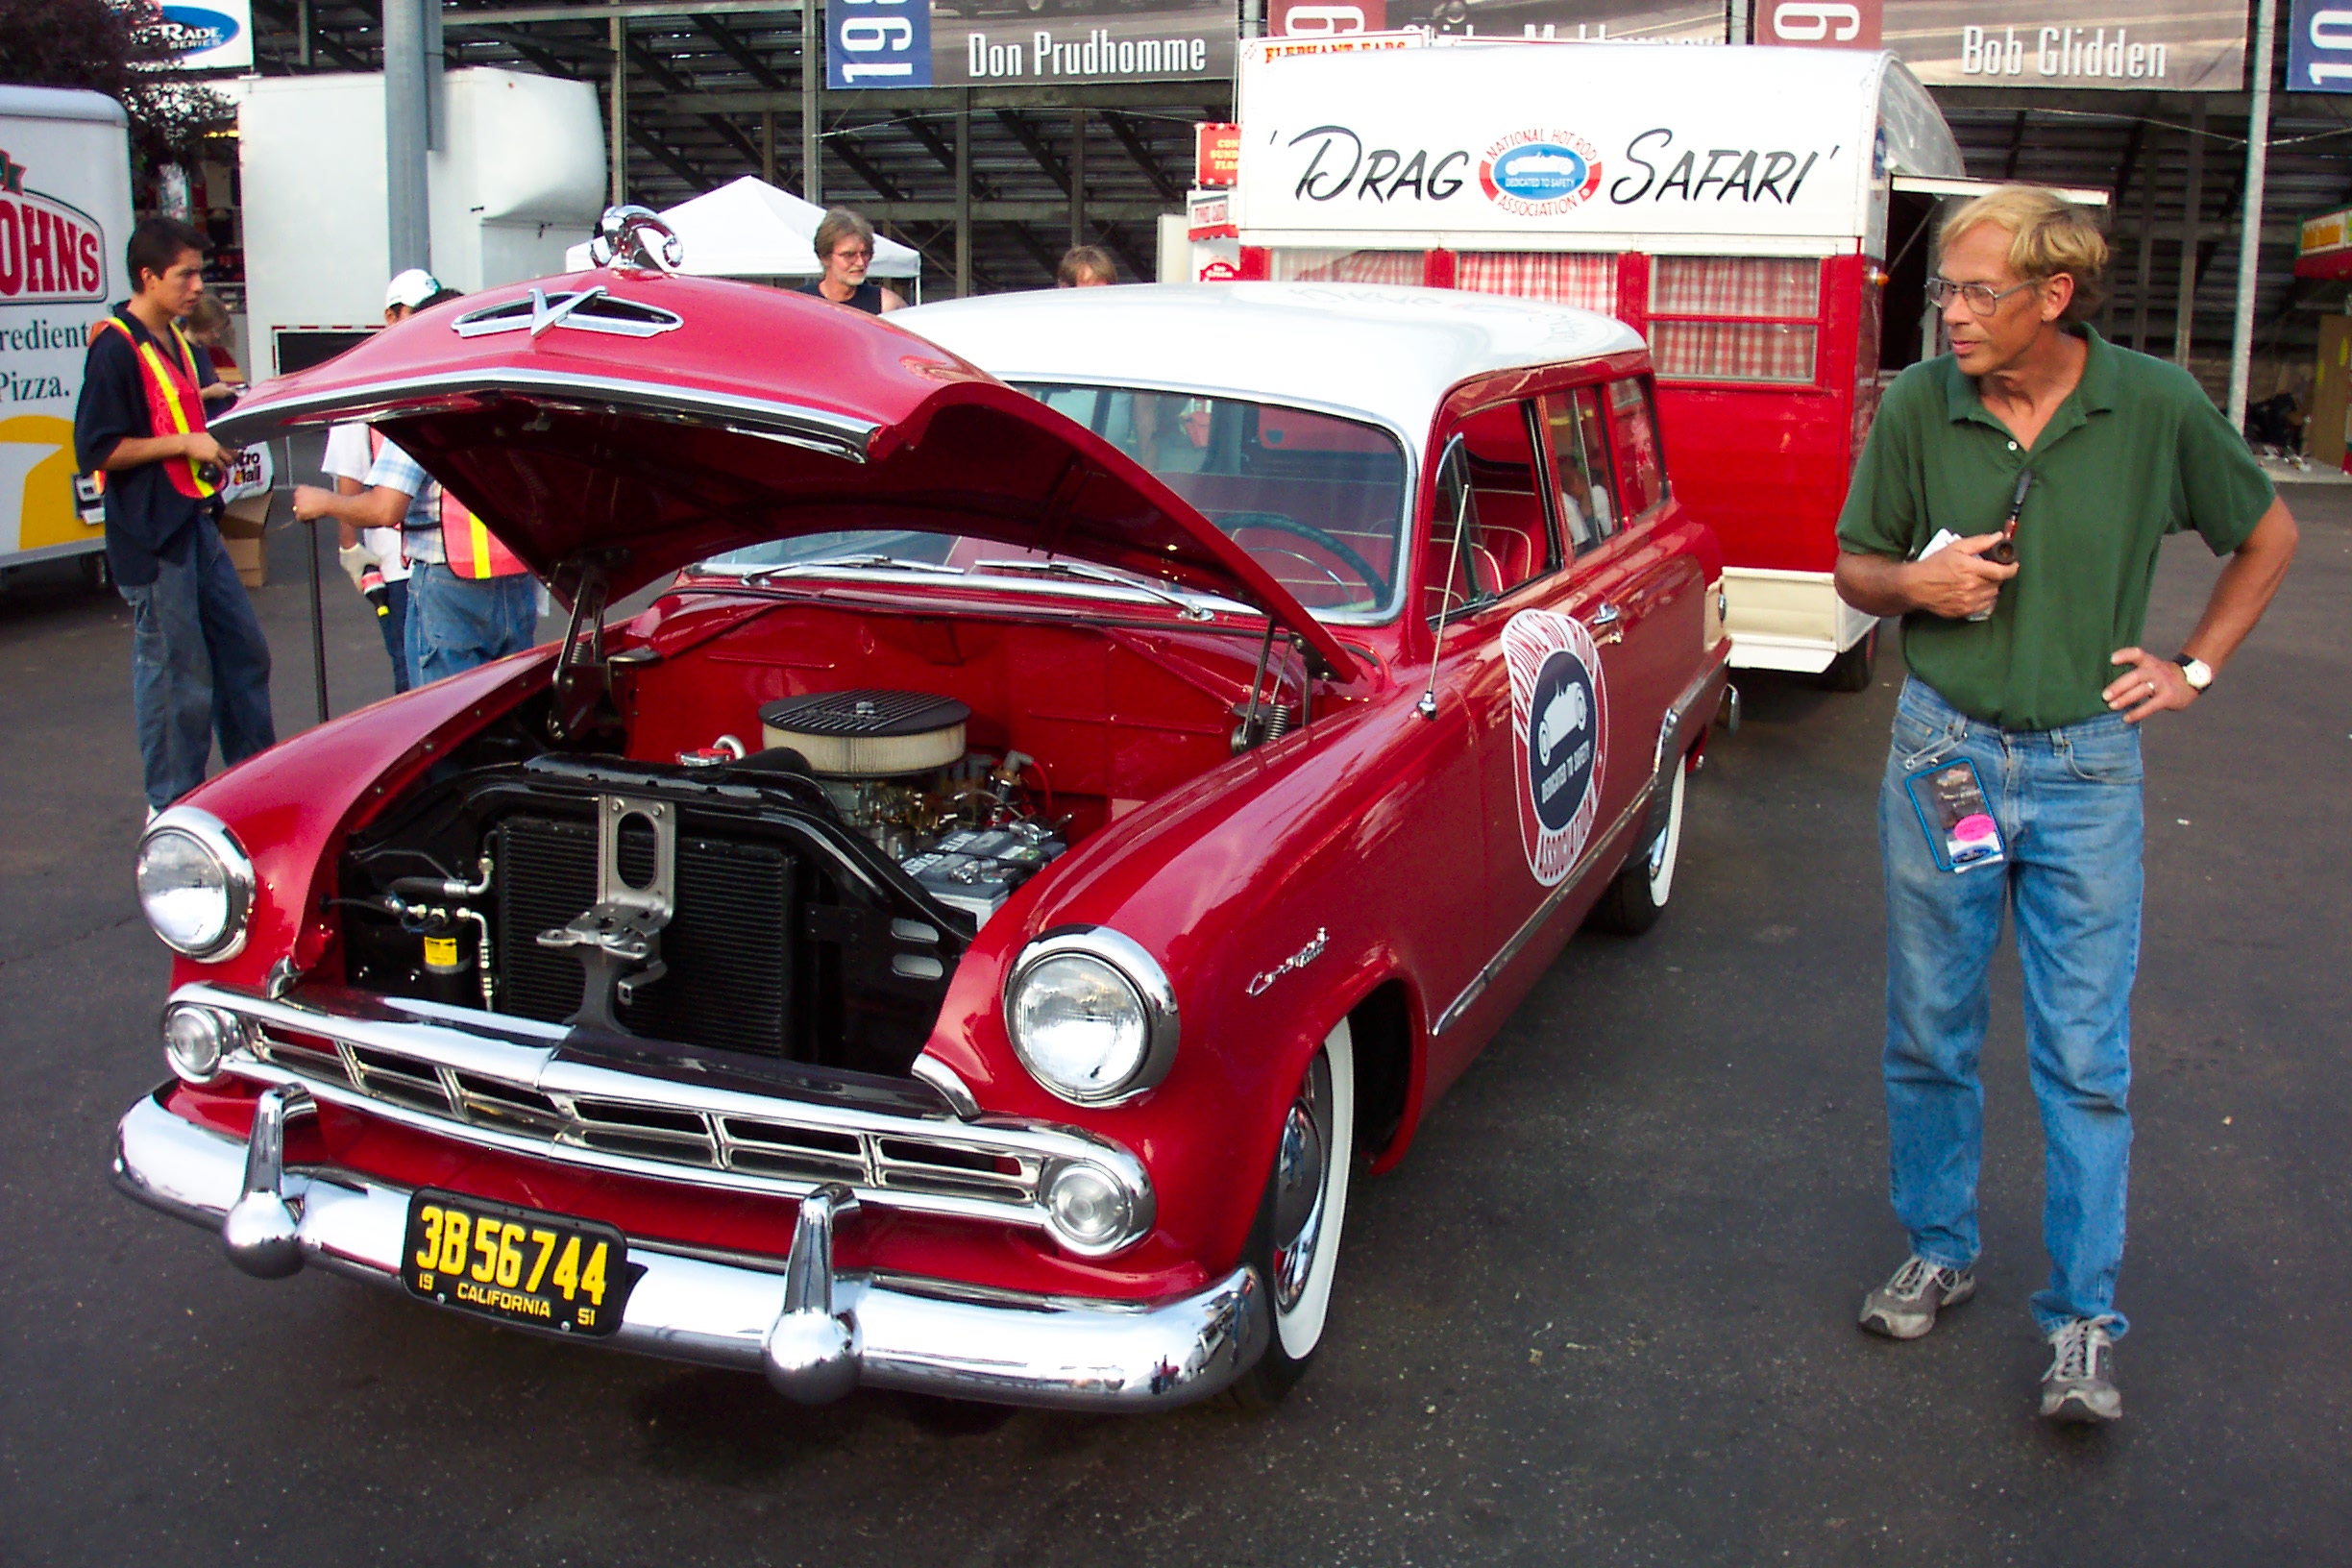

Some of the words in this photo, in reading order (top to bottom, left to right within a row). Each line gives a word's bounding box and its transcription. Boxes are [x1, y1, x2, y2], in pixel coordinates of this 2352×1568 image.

[841, 0, 913, 84] 19
[968, 32, 1023, 78] Don
[1033, 30, 1206, 76] Prudhomme
[1962, 25, 2023, 75] Bob
[2038, 26, 2167, 79] Glidden
[1486, 129, 1545, 159] NATIONAL
[1552, 129, 1576, 146] HOT
[1573, 137, 1598, 161] ROD
[1497, 194, 1578, 217] ASSOCIATION
[418, 1272, 434, 1292] 19
[456, 1282, 551, 1319] CALIFORNIA
[577, 1307, 596, 1327] 51
